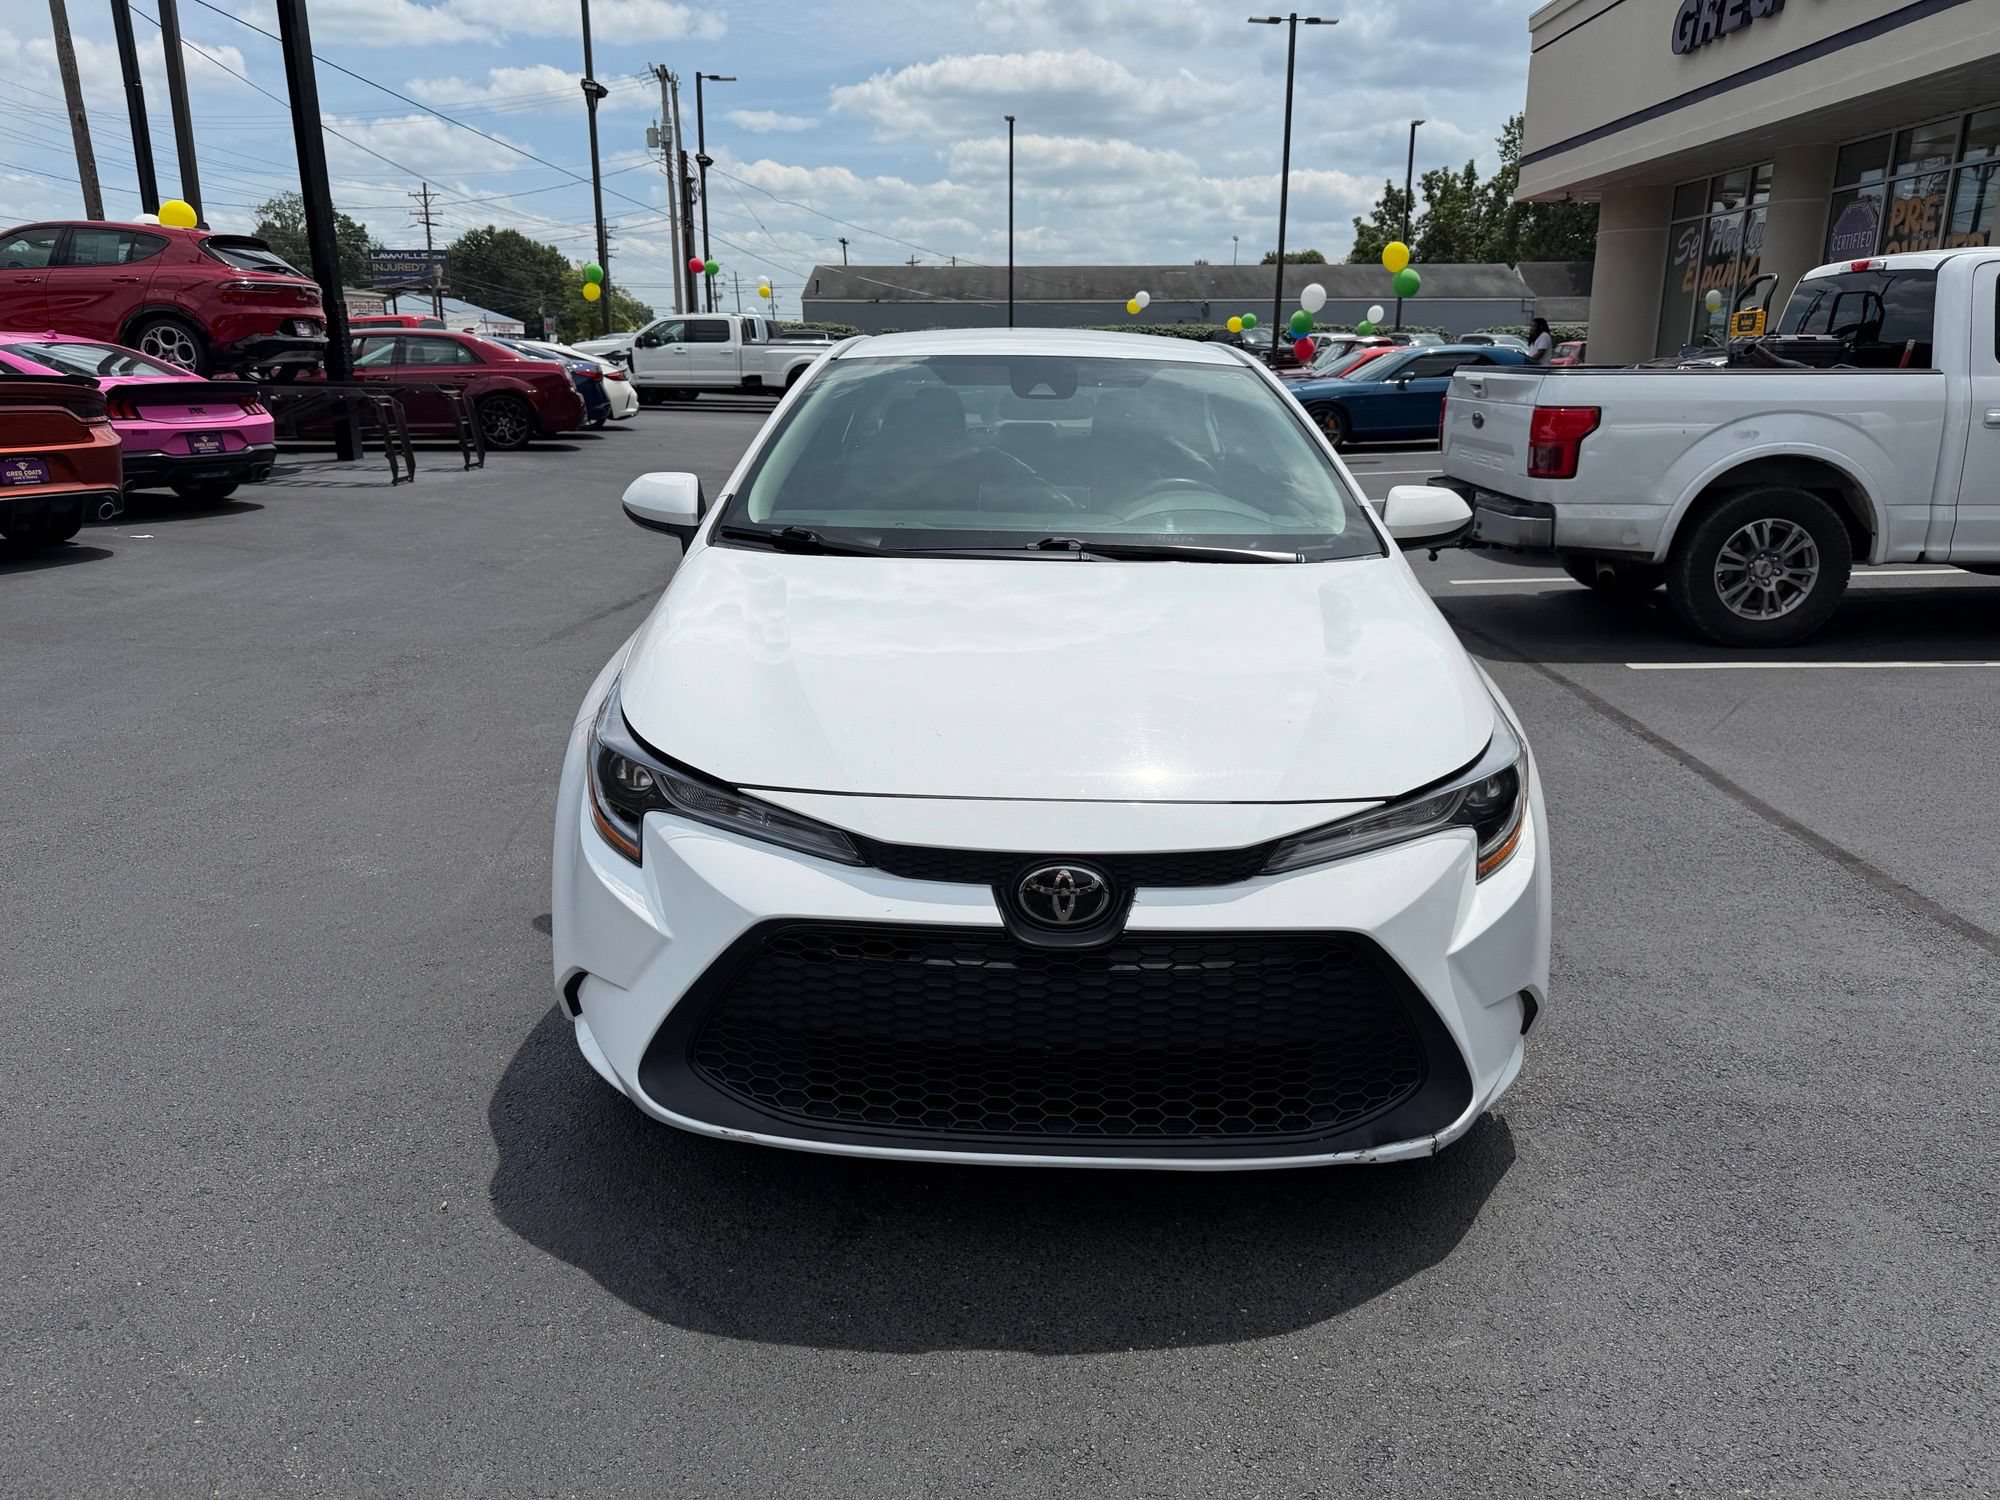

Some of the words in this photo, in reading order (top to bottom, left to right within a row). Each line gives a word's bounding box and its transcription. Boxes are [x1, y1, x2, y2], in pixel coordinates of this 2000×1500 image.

[1888, 195, 1940, 238] PRE
[1674, 226, 1700, 266] Se
[1708, 211, 1765, 256] Hala
[1832, 231, 1873, 251] CERTIFIED
[372, 263, 426, 272] INJURED?
